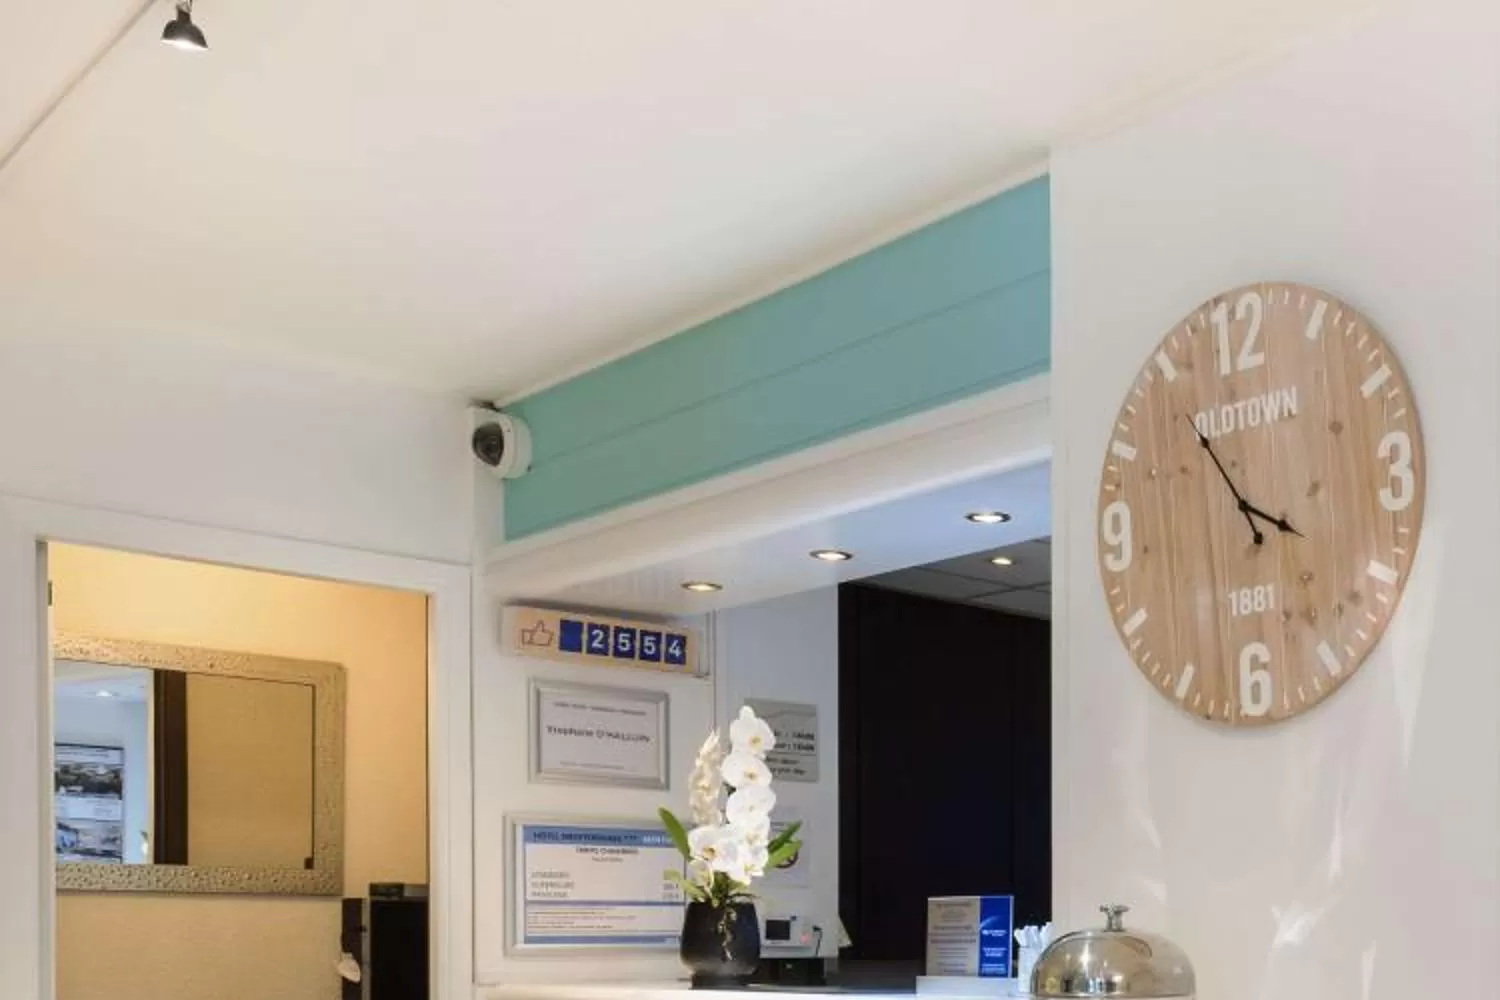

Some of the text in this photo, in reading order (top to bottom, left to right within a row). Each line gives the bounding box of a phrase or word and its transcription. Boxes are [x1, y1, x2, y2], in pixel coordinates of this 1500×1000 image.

[1209, 291, 1266, 376] 12
[1195, 385, 1297, 441] OLDTOWN
[1377, 431, 1414, 512] 3
[1103, 501, 1132, 572] 9
[1227, 583, 1277, 617] 1881
[590, 629, 682, 660] 2554
[1239, 642, 1272, 717] 6
